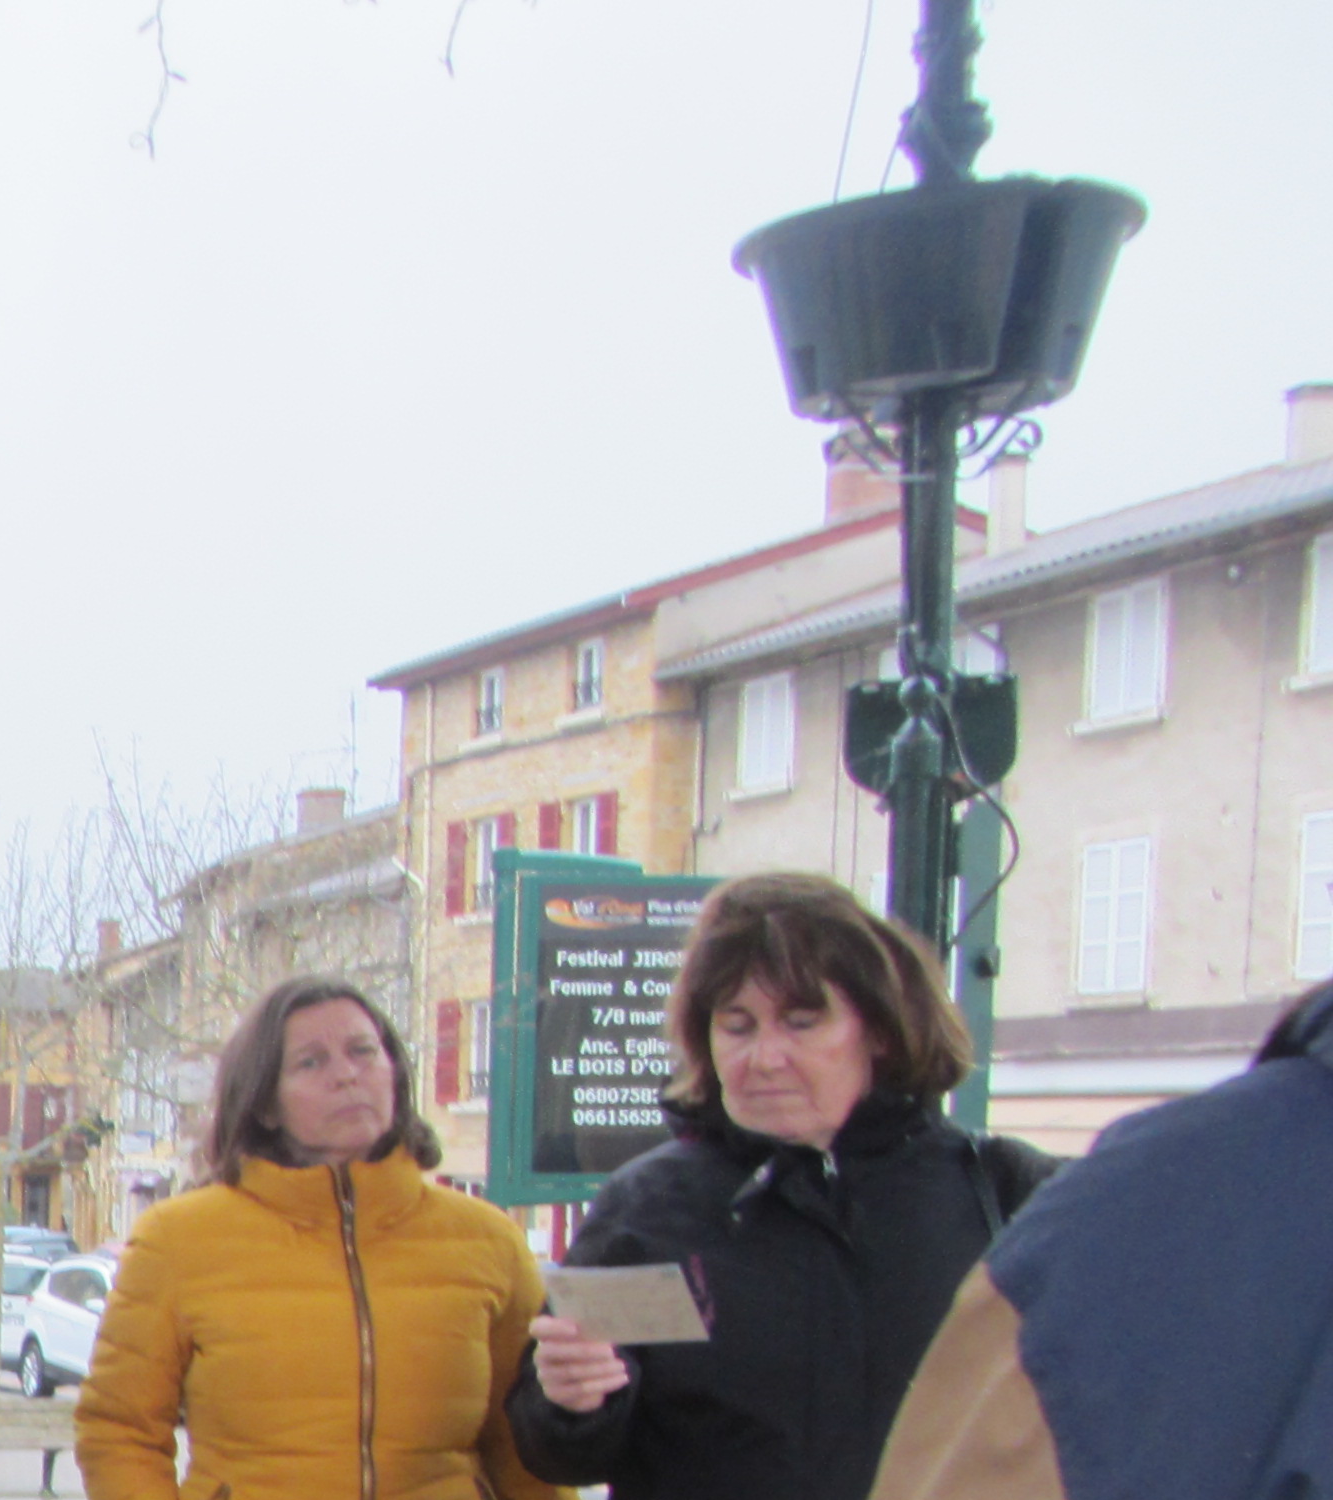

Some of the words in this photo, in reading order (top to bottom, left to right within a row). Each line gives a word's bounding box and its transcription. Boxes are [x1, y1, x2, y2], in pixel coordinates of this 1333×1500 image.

[556, 949, 624, 967] Festival
[550, 979, 613, 996] Femme
[624, 980, 637, 997] &
[592, 1008, 625, 1027] 7/8
[629, 1011, 667, 1026] mar
[580, 1038, 619, 1055] Anc.
[552, 1058, 574, 1075] LE
[579, 1058, 625, 1075] BOIS
